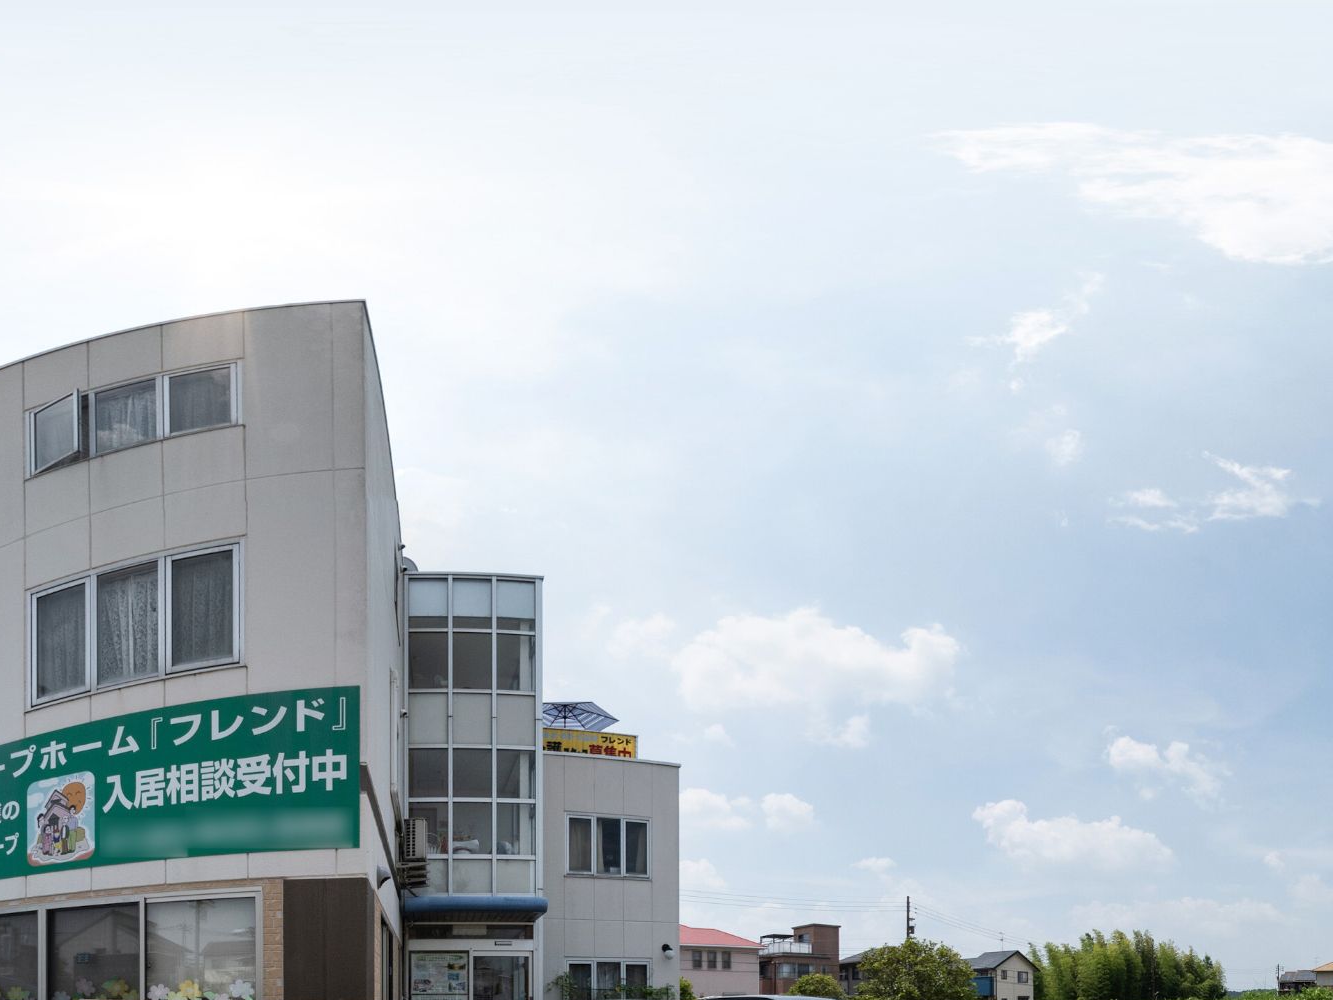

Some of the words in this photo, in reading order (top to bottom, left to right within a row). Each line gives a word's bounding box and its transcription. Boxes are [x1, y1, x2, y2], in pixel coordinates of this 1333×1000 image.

[102, 749, 348, 814] 入居相談受付中
